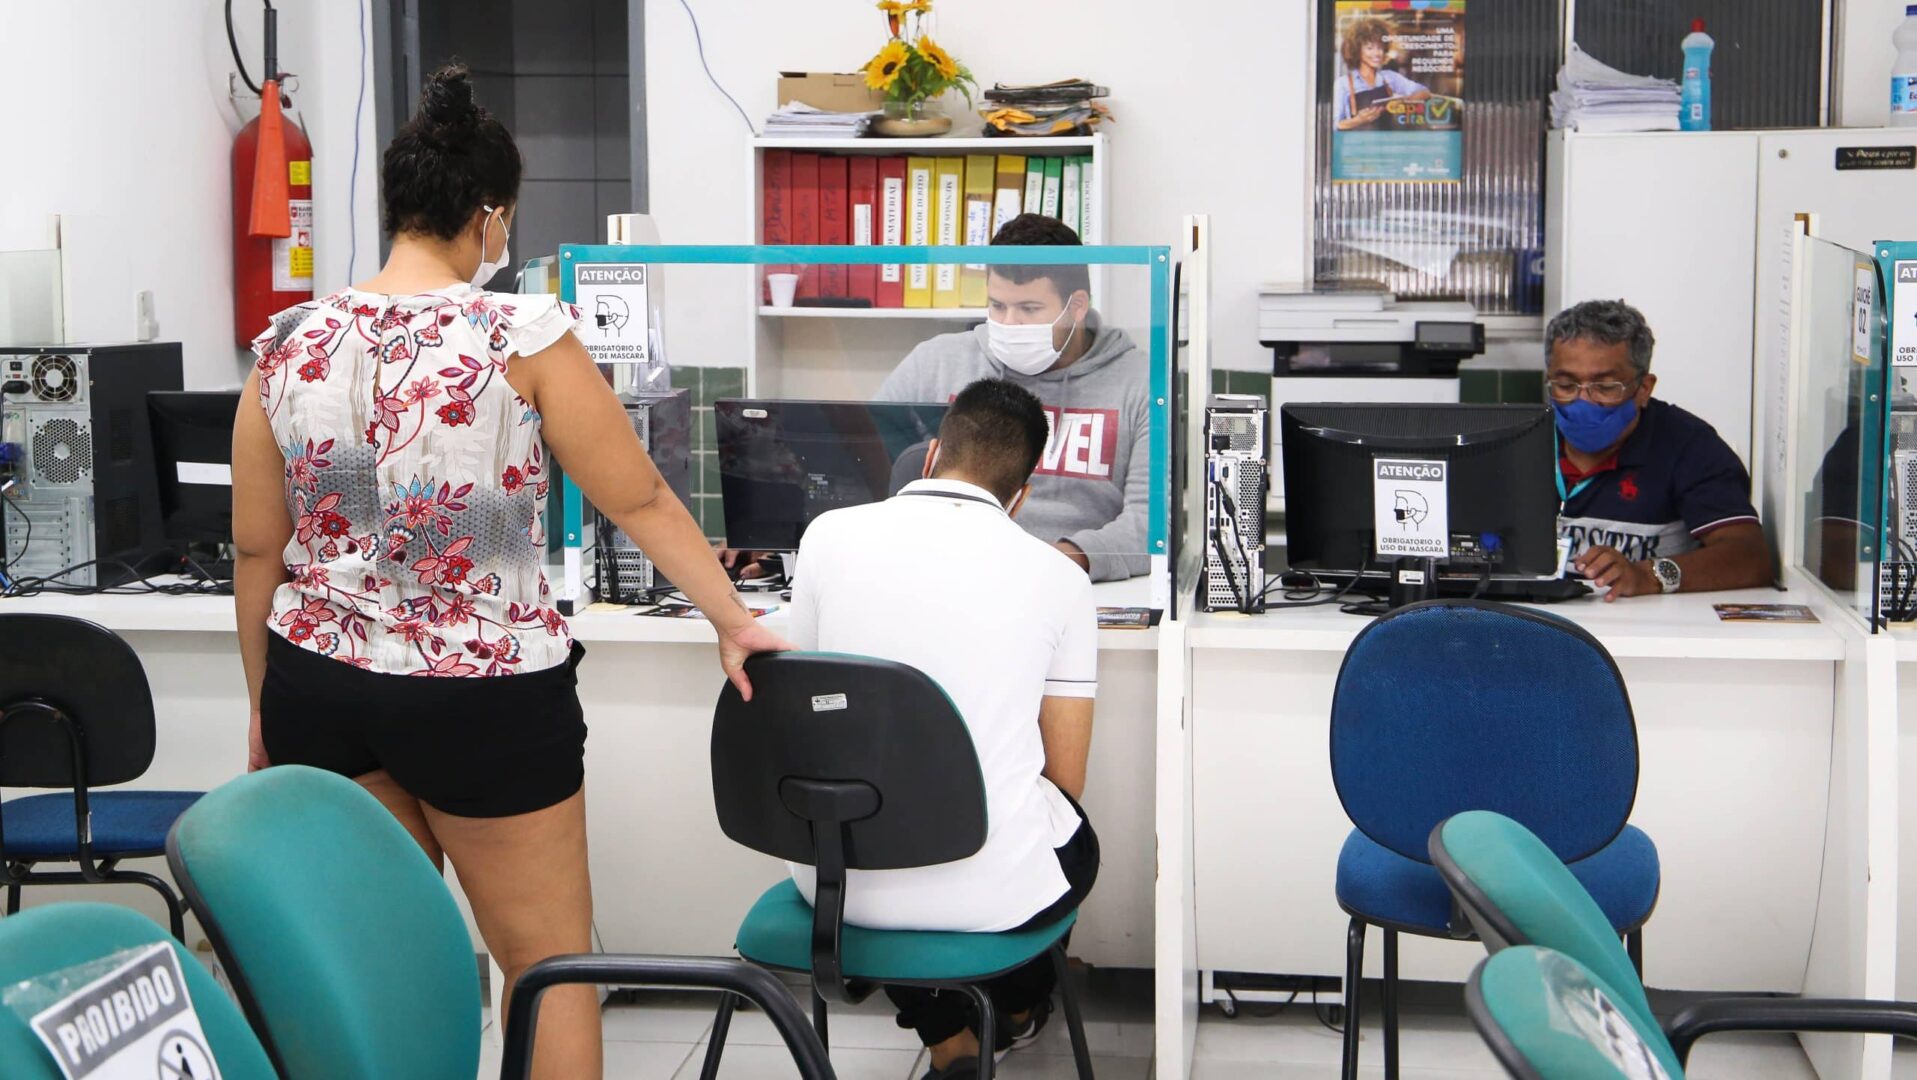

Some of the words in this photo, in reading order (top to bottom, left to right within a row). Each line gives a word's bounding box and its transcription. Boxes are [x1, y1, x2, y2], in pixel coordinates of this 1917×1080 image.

[888, 184, 897, 233] MATERIAL
[581, 268, 641, 283] ATENÇÃO
[1859, 306, 1866, 335] 02
[599, 352, 608, 360] DE
[1379, 464, 1442, 480] ATENÇÃO
[1380, 544, 1396, 552] USO
[1435, 538, 1442, 546] O
[57, 965, 177, 1066] PROIBIDO
